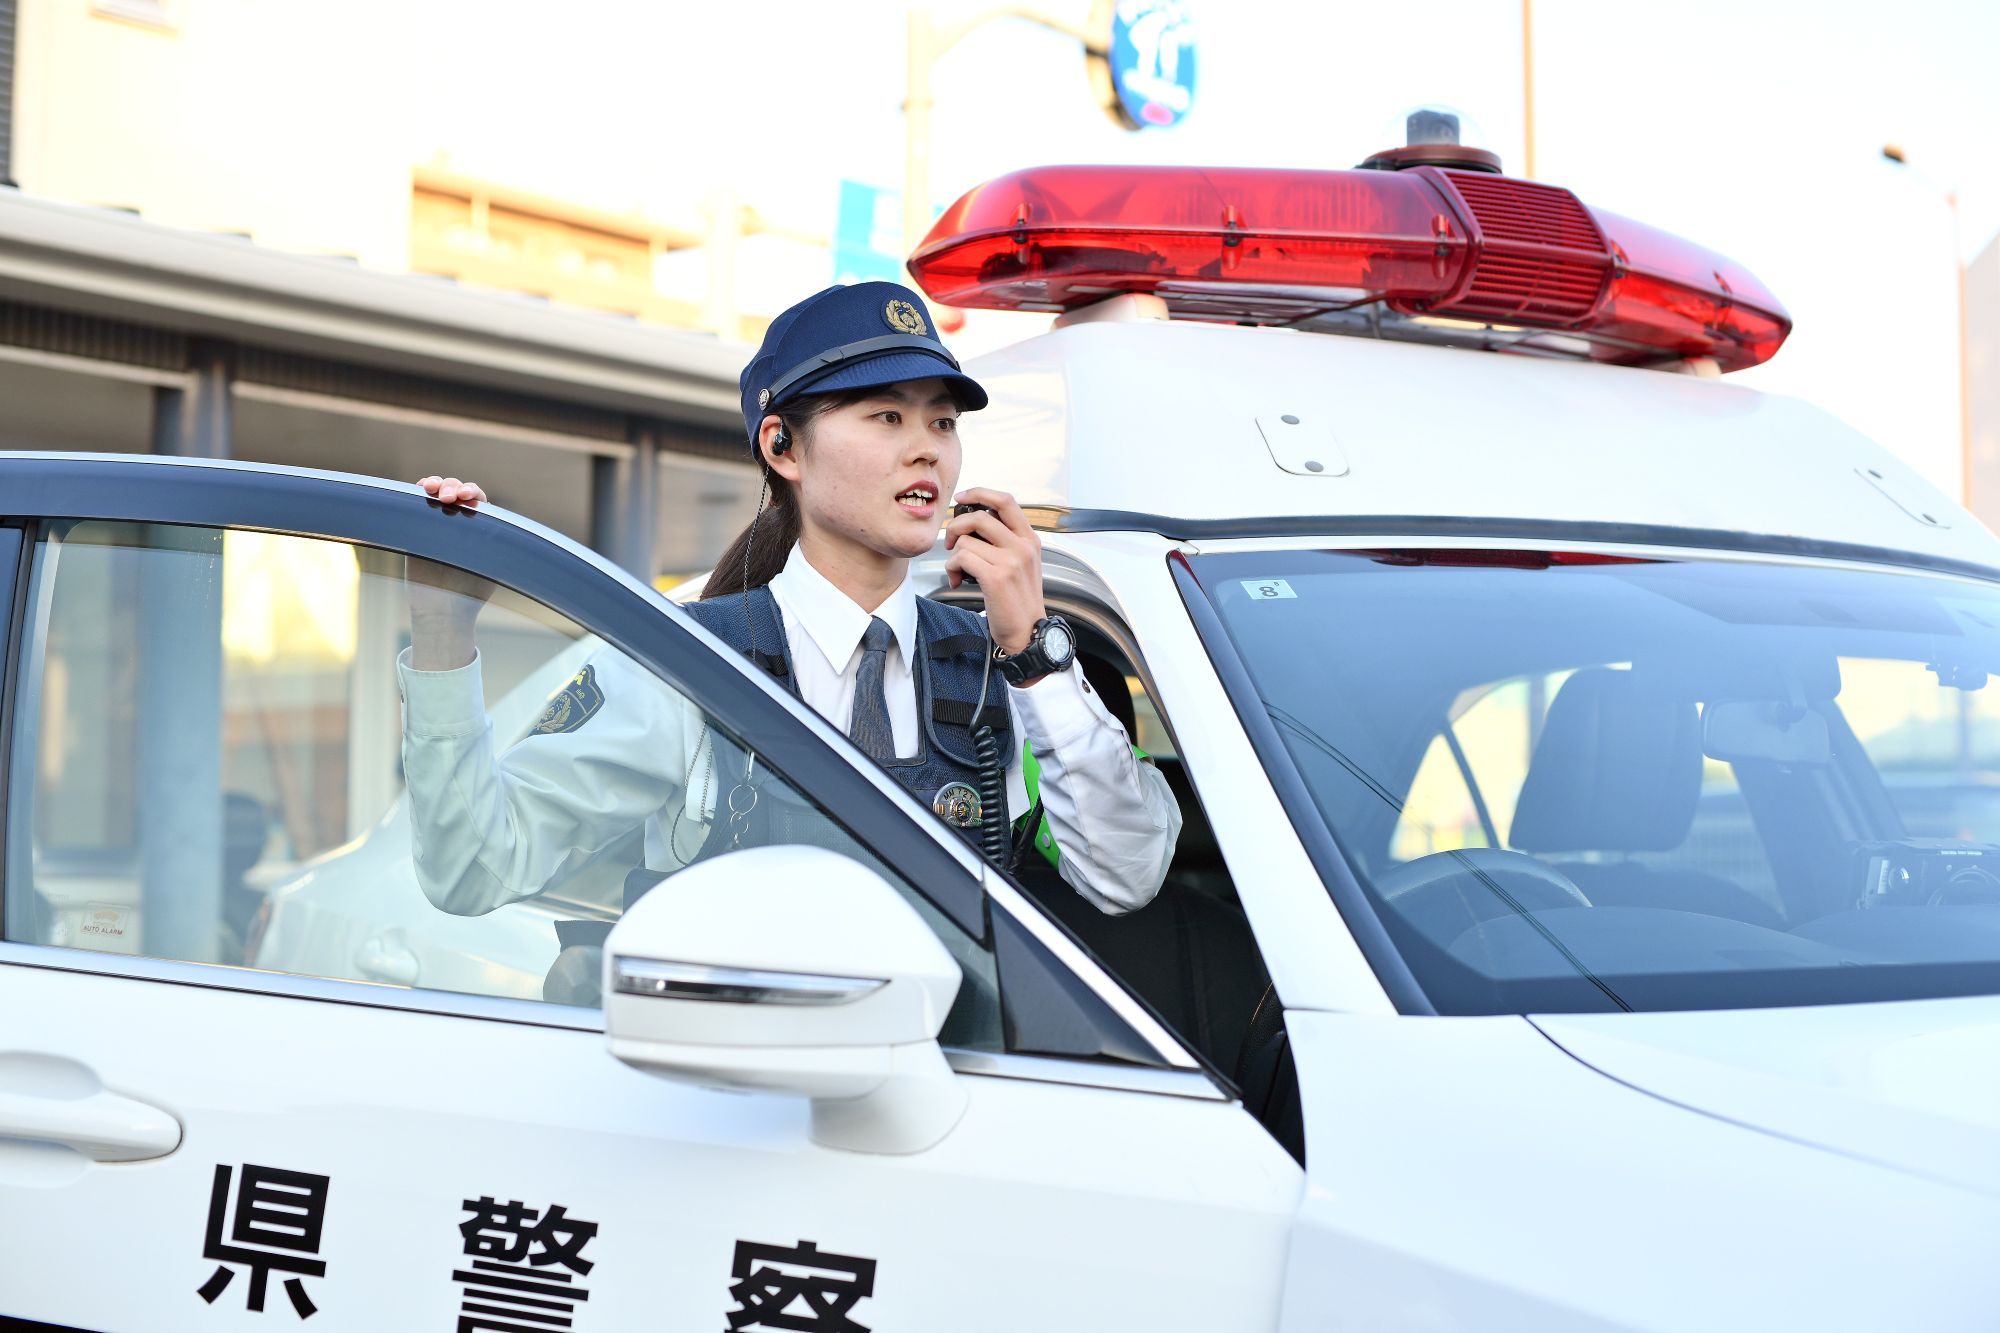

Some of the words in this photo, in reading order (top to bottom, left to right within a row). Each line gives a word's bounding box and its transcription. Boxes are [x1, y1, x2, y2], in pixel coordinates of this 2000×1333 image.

[1259, 586, 1279, 597] 8
[83, 925, 100, 933] AUTO
[101, 927, 124, 936] ALARM
[197, 1163, 877, 1333] 県警察
